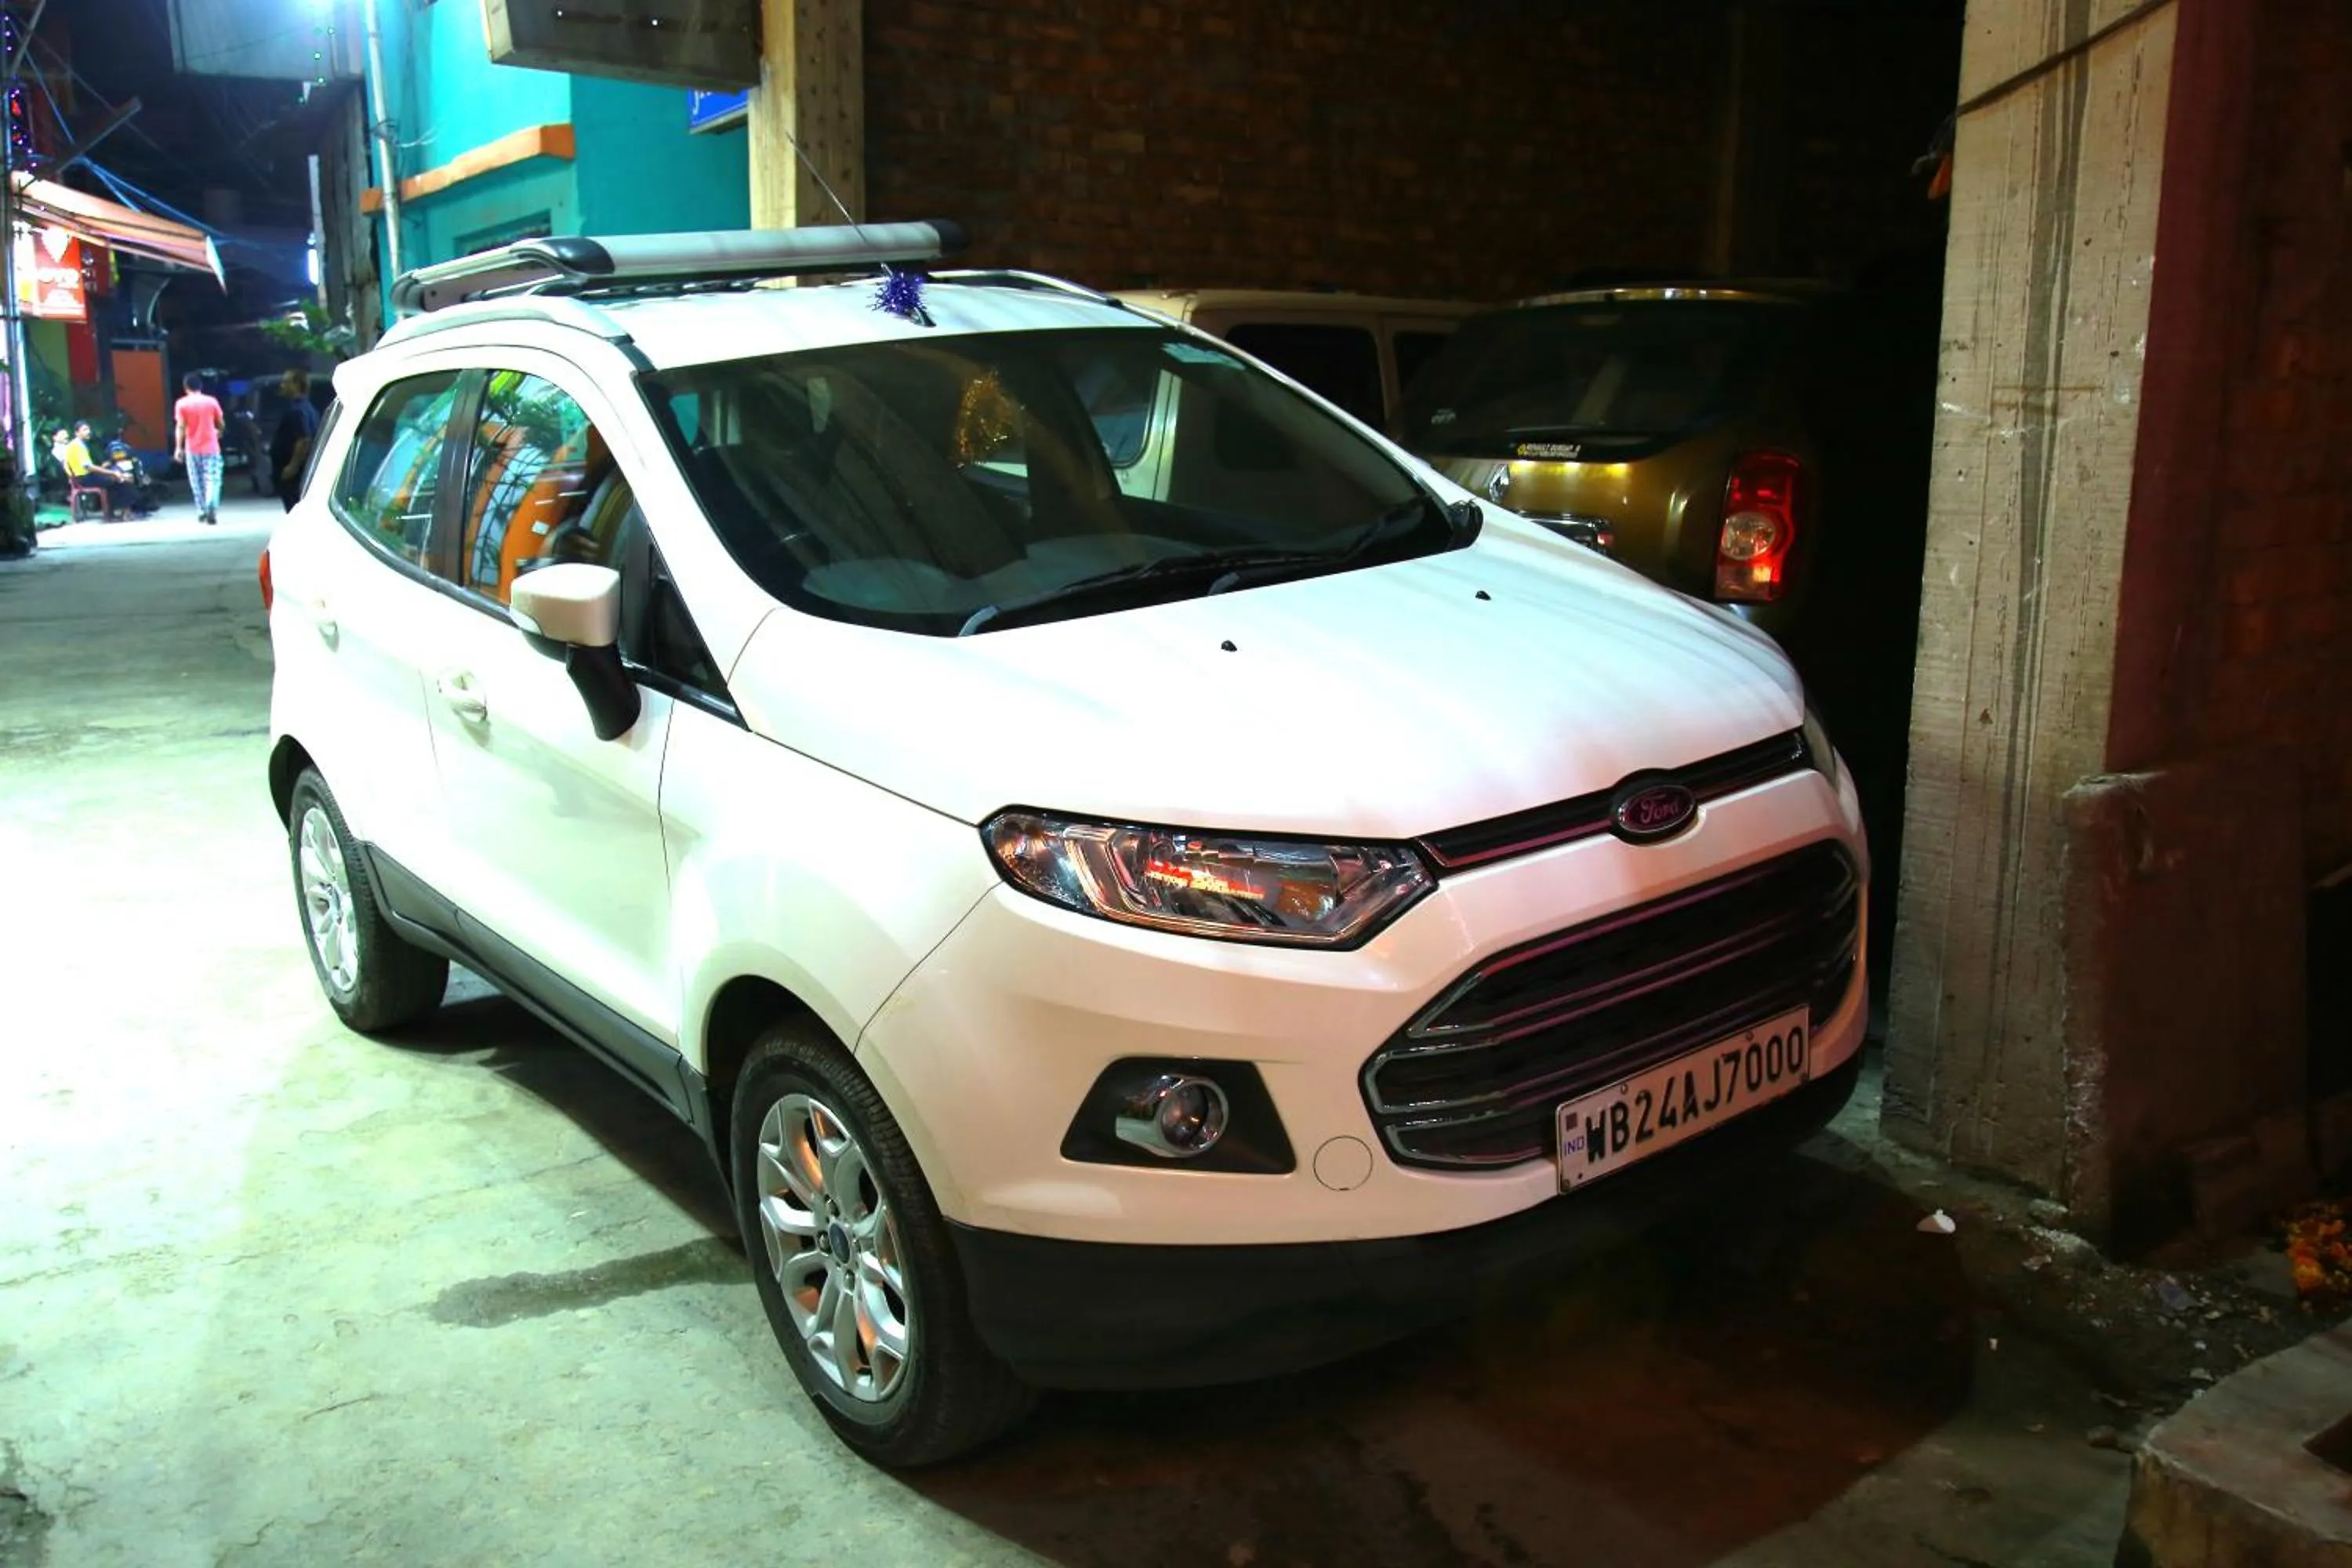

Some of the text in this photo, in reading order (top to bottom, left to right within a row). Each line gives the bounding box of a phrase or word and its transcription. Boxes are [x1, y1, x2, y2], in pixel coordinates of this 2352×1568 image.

[1640, 793, 1679, 824] Ford
[1585, 1026, 1803, 1164] WB24AJ7000
[1564, 1134, 1584, 1156] IND
